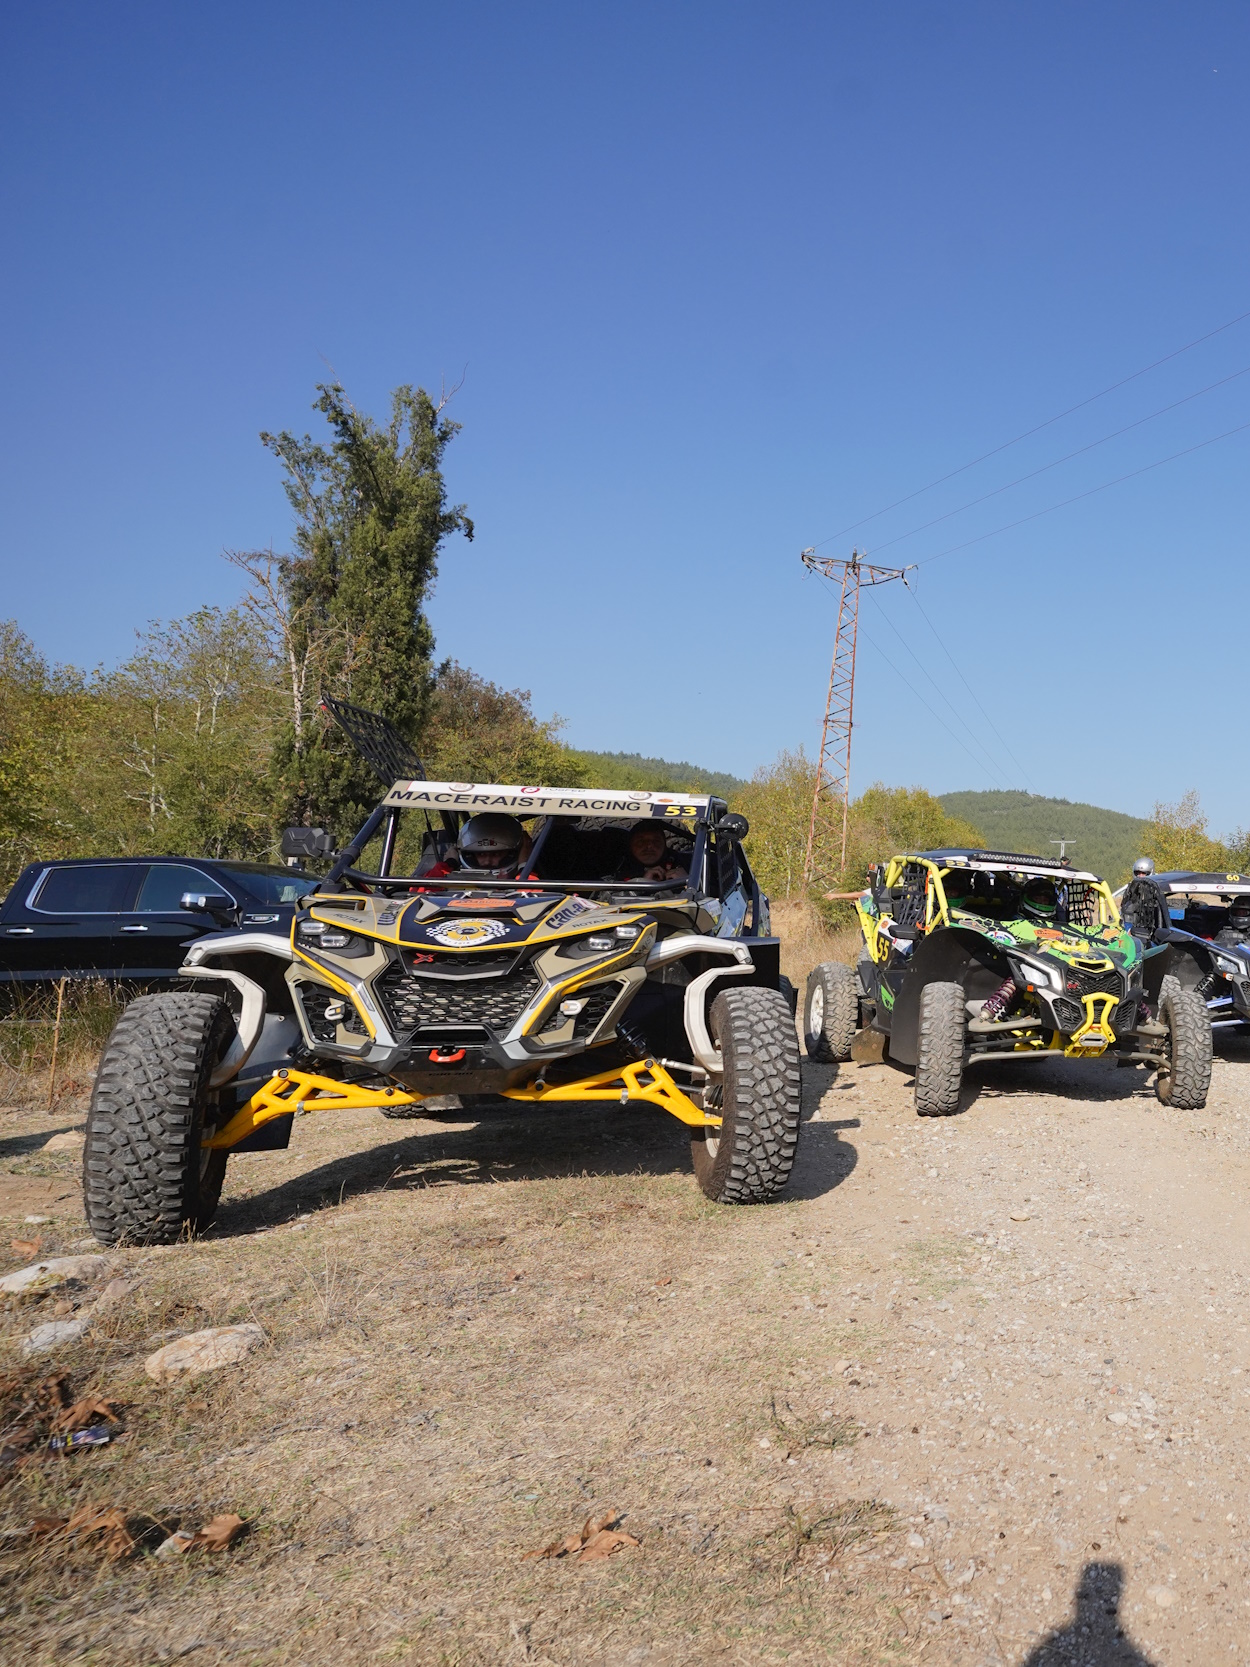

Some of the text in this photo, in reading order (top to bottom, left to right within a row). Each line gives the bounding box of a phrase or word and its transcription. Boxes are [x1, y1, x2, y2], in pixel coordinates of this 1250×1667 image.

[390, 791, 552, 808] MACERAIST
[558, 798, 641, 812] RACING
[664, 806, 697, 816] 53
[572, 918, 608, 928] ROTAX
[877, 937, 890, 961] 55
